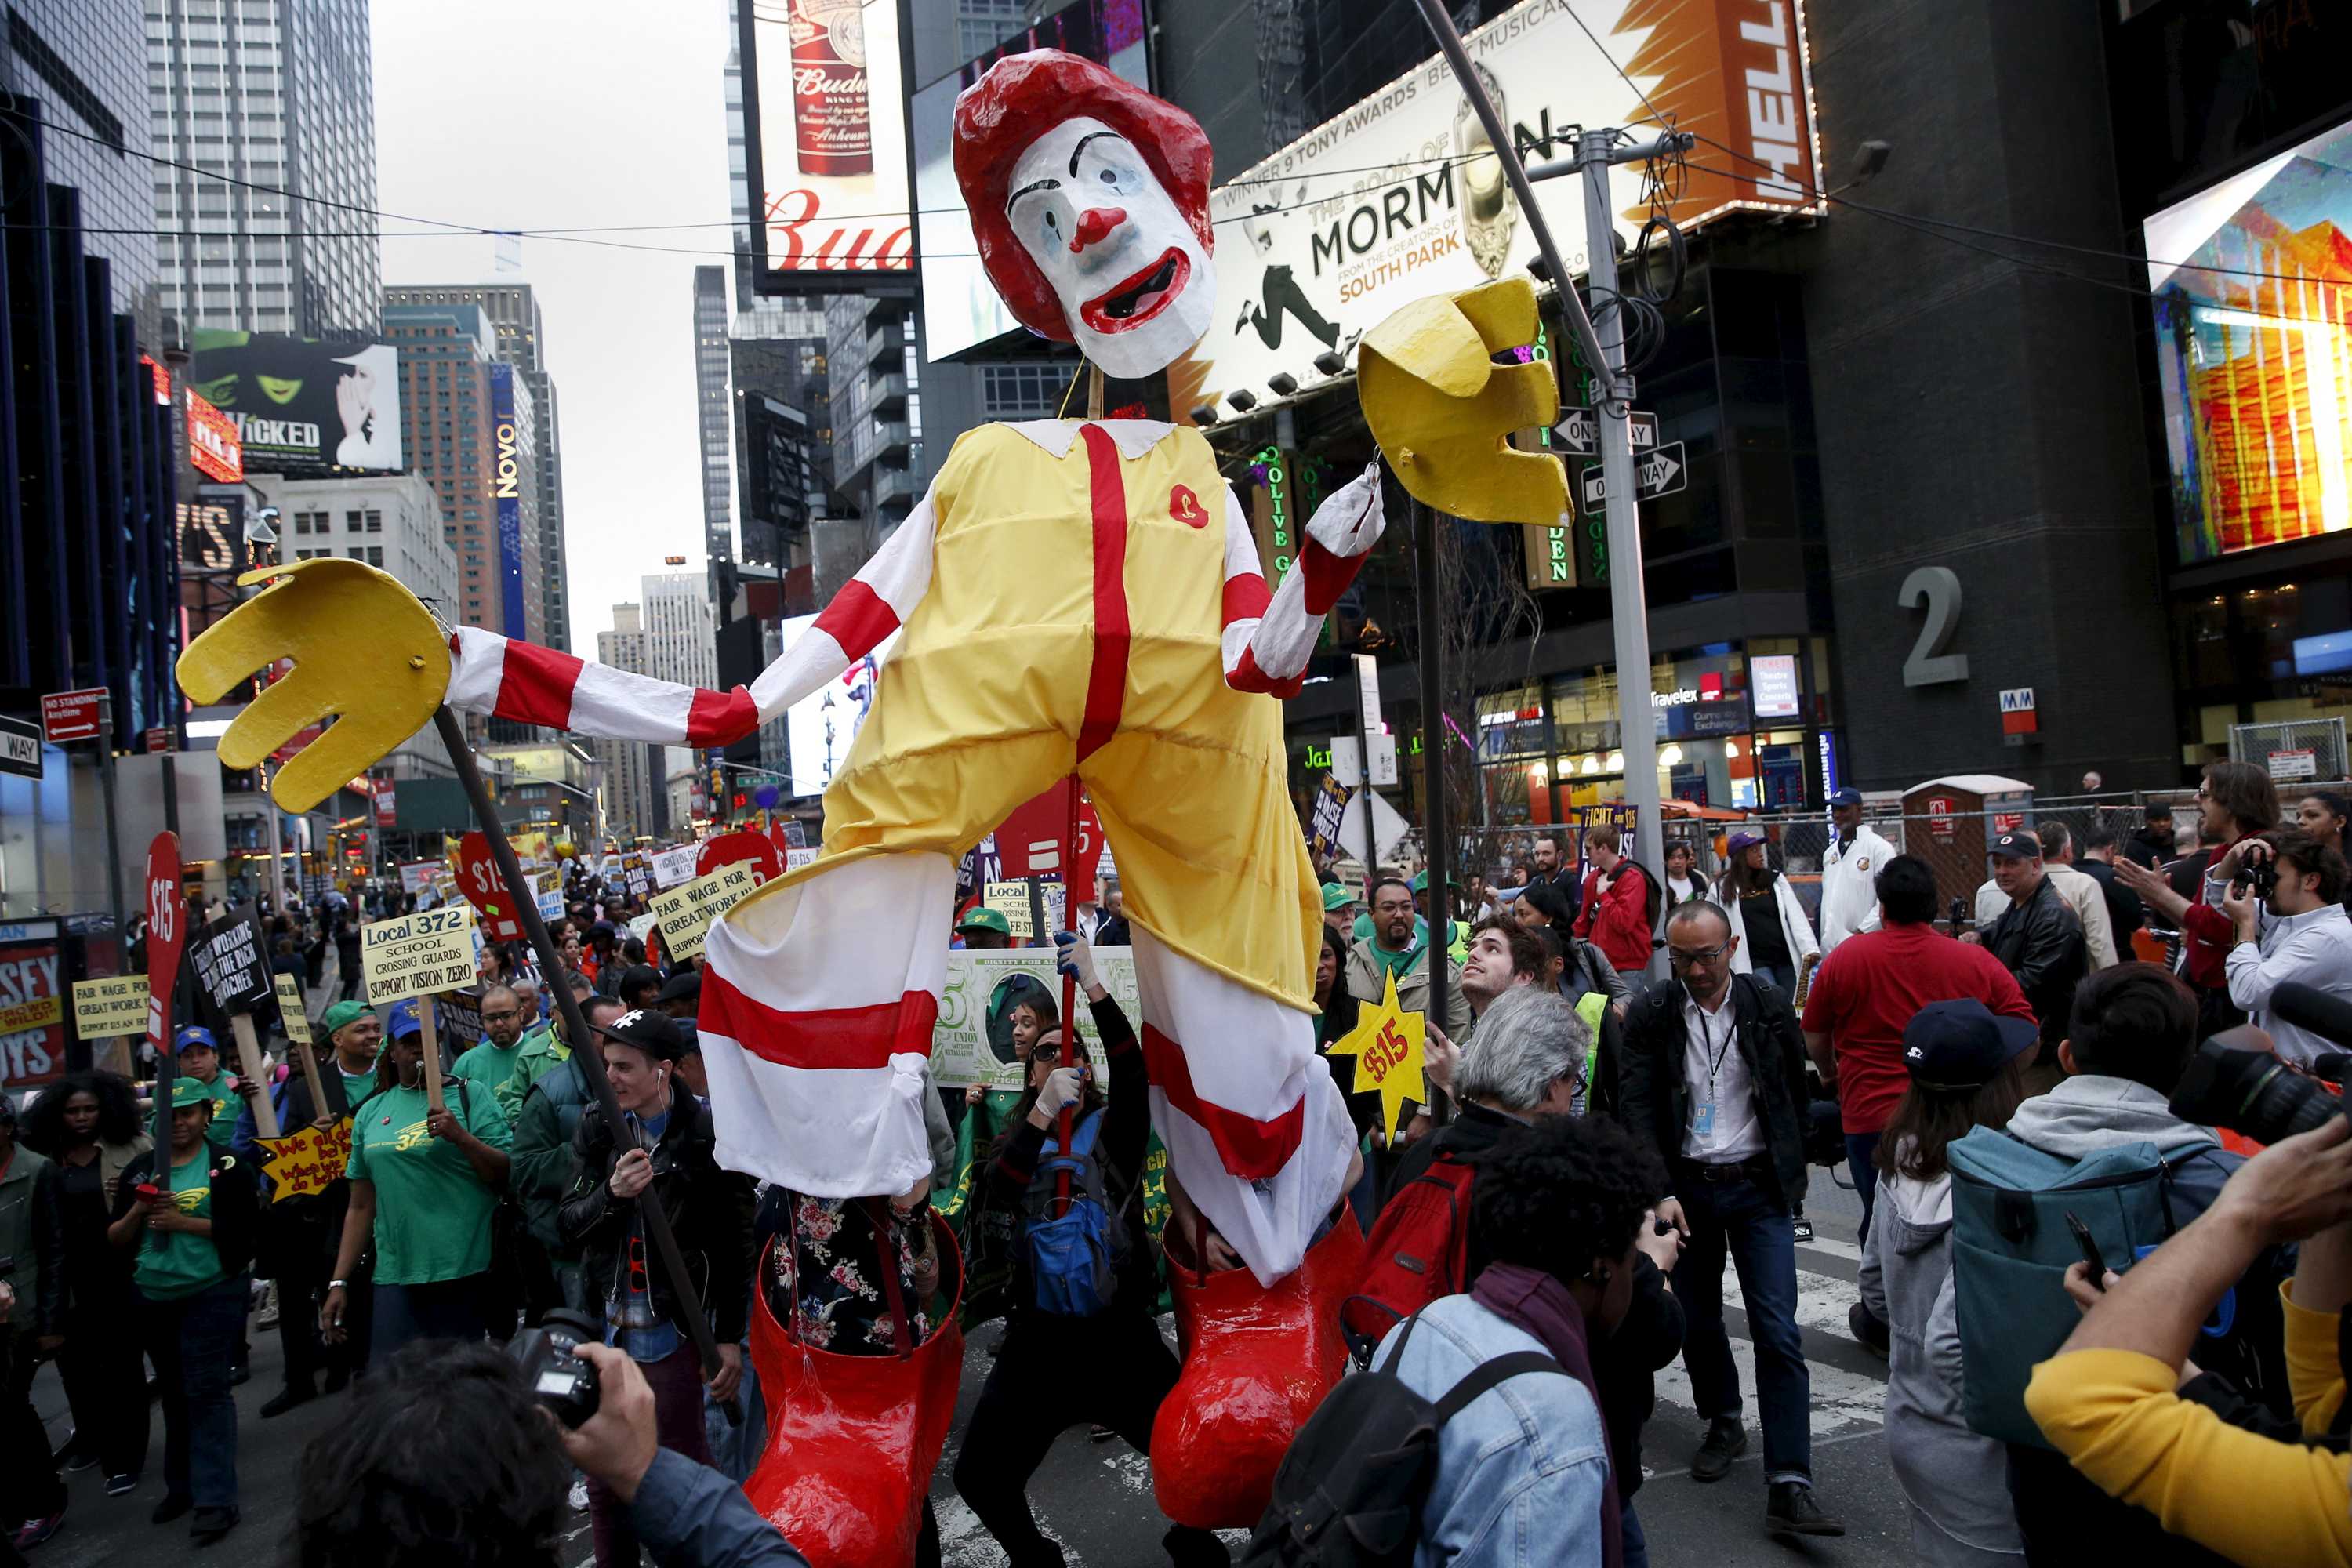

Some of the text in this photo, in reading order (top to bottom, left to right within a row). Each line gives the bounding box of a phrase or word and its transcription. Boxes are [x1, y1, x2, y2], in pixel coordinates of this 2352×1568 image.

[1222, 163, 1279, 208] WINNER
[1284, 159, 1294, 172] 9
[1296, 129, 1340, 165] TONY
[1344, 82, 1417, 138] AWARDS
[1308, 132, 1449, 228] THE BOOK OF
[1338, 216, 1457, 282] FROM THE CREATORS OF
[1340, 230, 1461, 303] SOUTH PARK
[1268, 466, 1289, 546] OLIVE
[1898, 567, 1969, 687] 2
[1650, 688, 1698, 707] Travelex
[1759, 692, 1791, 702] Concerts
[1762, 681, 1787, 691] Sports
[45, 699, 57, 709] NO
[47, 708, 81, 720] Anytime
[7, 735, 35, 760] WAY
[1584, 808, 1613, 828] FIGHT
[655, 898, 684, 918] FAIR
[686, 880, 720, 903] WAGE
[723, 869, 747, 889] FOR
[989, 884, 1025, 898] Local
[151, 877, 173, 942] $15
[664, 908, 703, 935] GREAT
[705, 894, 739, 917] WORK
[211, 920, 252, 956] WORKING
[367, 911, 463, 946] Local 372
[386, 939, 445, 958] SCHOOL
[672, 930, 707, 954] SUPPORT
[216, 953, 235, 978] THE
[234, 942, 257, 969] RICH
[376, 948, 462, 975] CROSSING GUARDS
[76, 988, 96, 1000] FAIR
[100, 983, 127, 996] WAGE
[370, 963, 471, 999] SUPPORT VISION ZERO
[78, 1001, 108, 1016] GREAT
[111, 996, 142, 1012] WORK
[81, 1022, 108, 1033] SUPPORT
[121, 1019, 133, 1028] AN
[953, 1032, 978, 1043] UNION
[1363, 1017, 1408, 1083] $15
[274, 1136, 308, 1158] We
